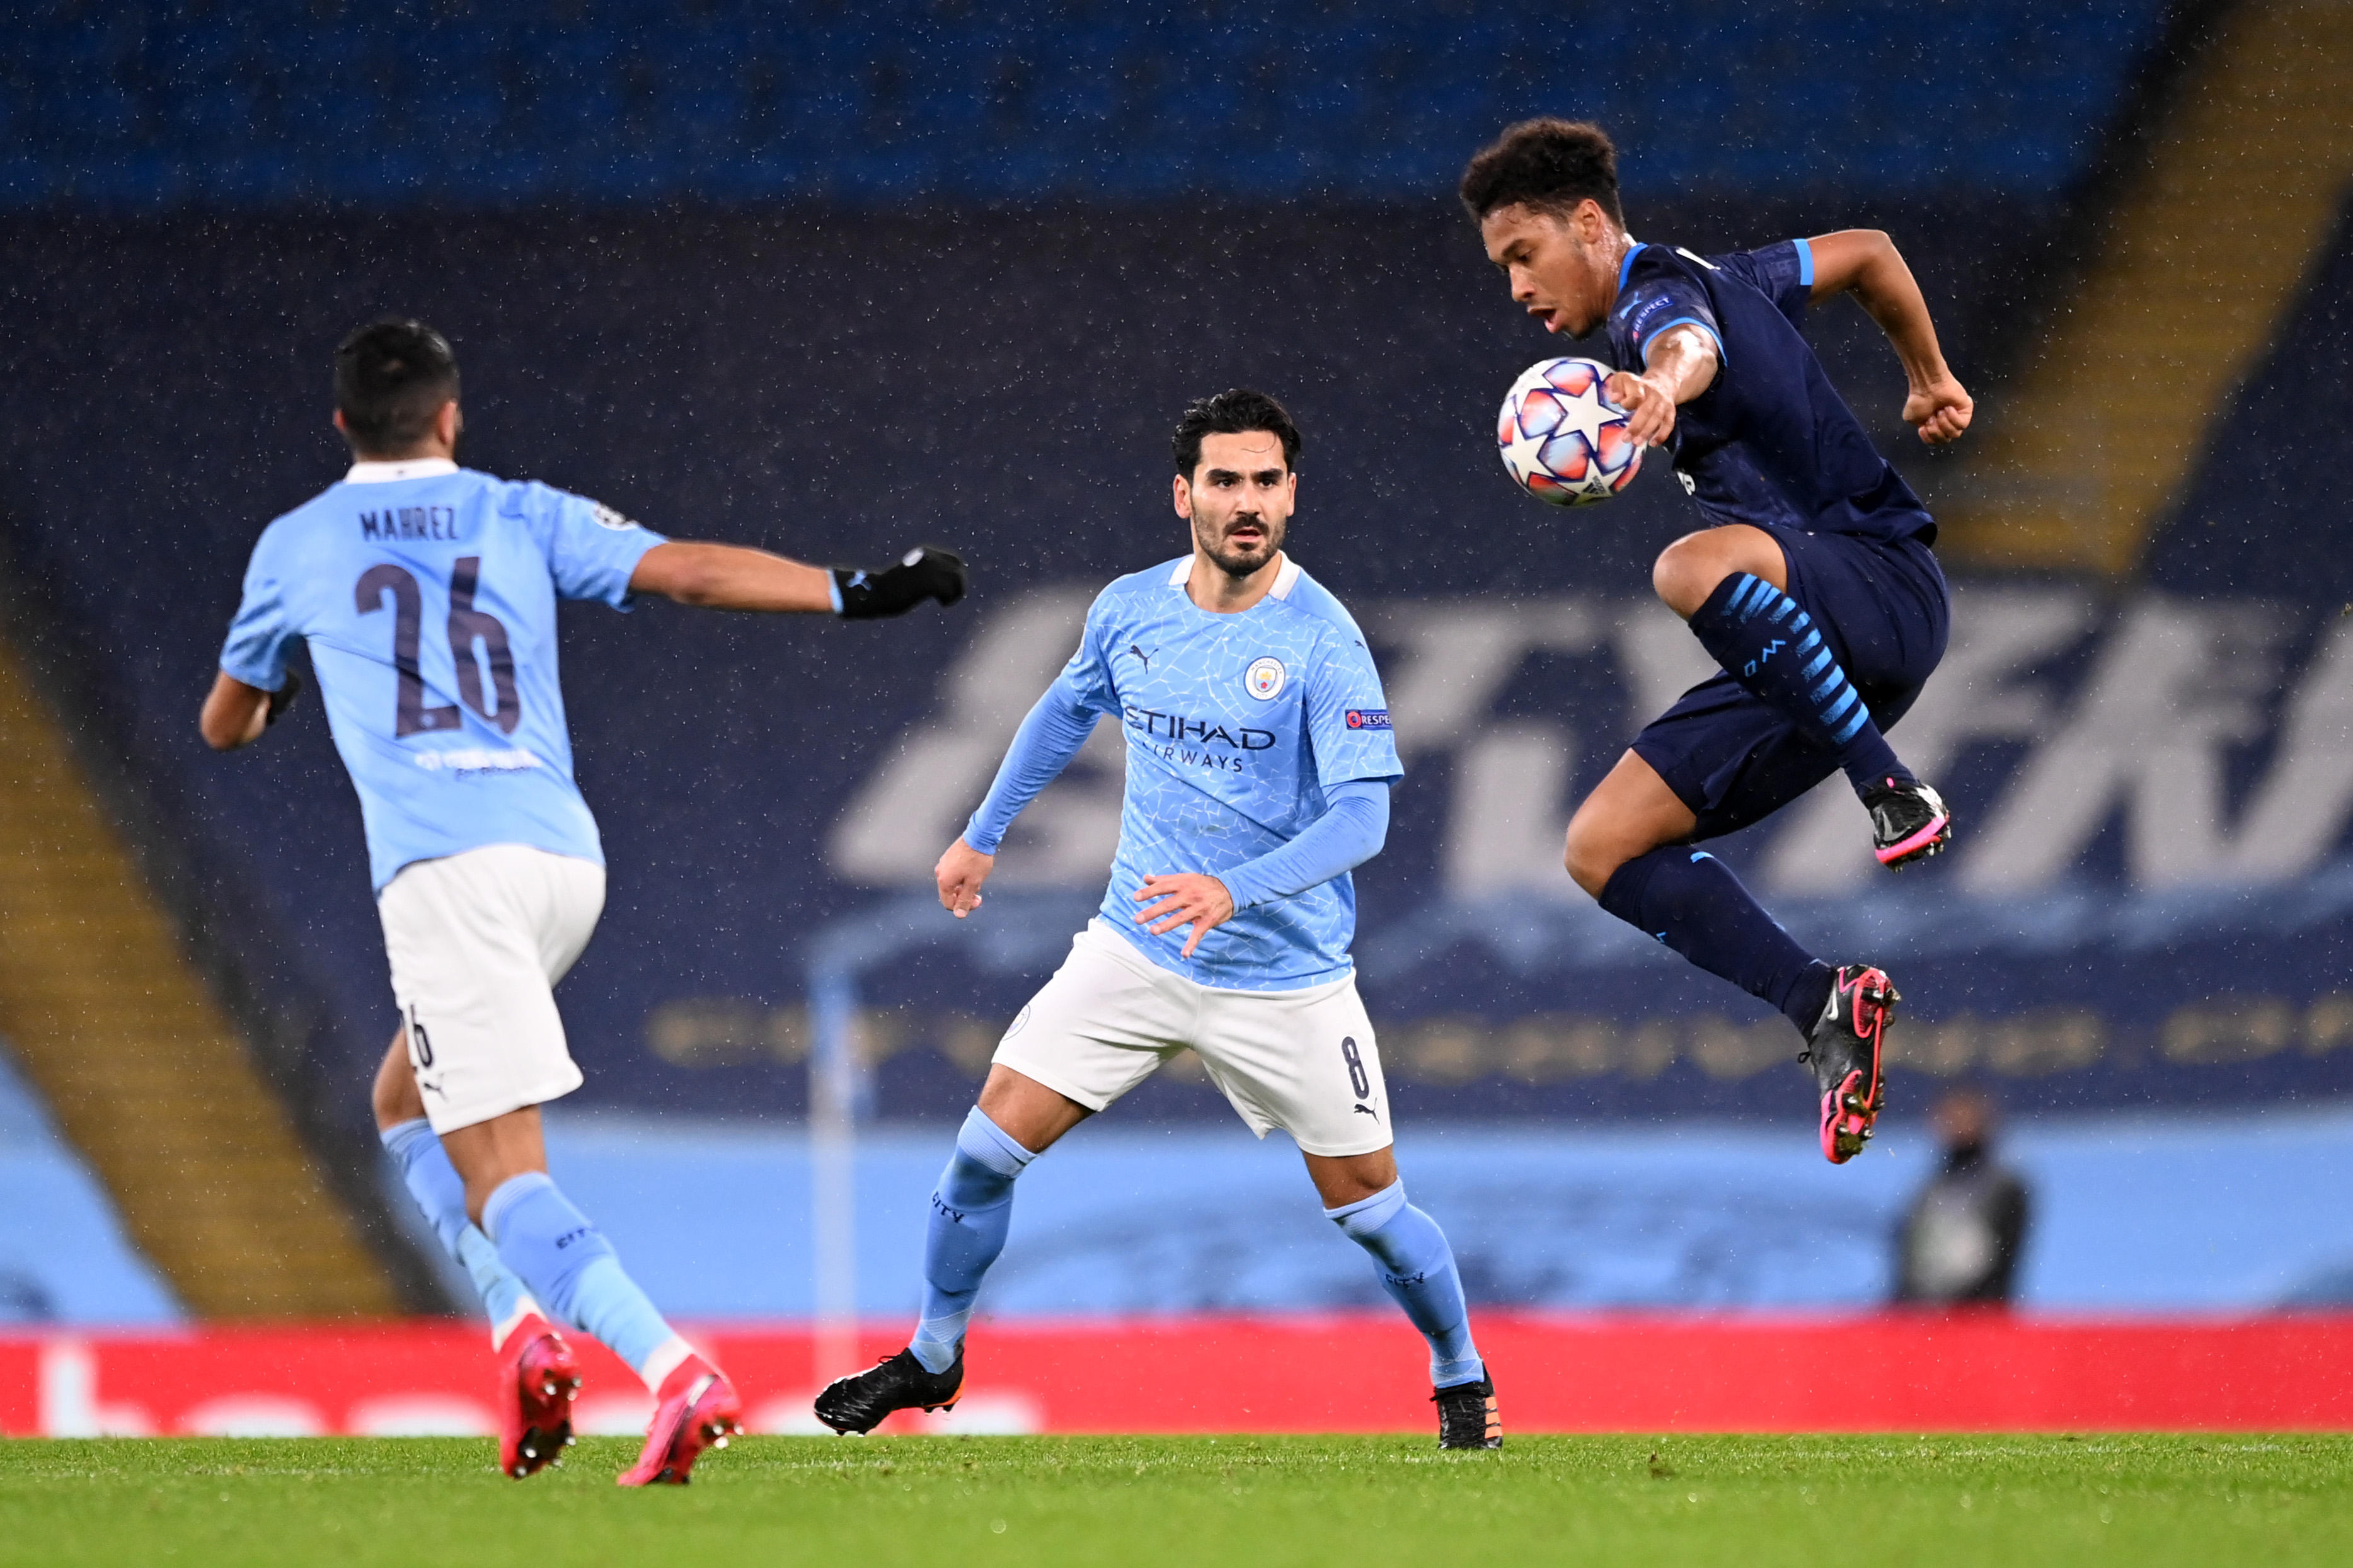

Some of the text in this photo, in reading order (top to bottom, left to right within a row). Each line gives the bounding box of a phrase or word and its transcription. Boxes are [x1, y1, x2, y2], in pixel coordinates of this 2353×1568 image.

[1635, 297, 1669, 331] RESPECT
[359, 506, 458, 541] MAHREZ
[354, 556, 522, 740] 26
[1251, 660, 1282, 674] MANCHESTER
[1125, 706, 1276, 750] ETIHAD
[1361, 715, 1391, 725] RESPE
[1341, 1036, 1369, 1100] 8
[933, 1191, 964, 1223] CITY
[556, 1228, 585, 1250] CIT
[1386, 1272, 1424, 1287] CITY
